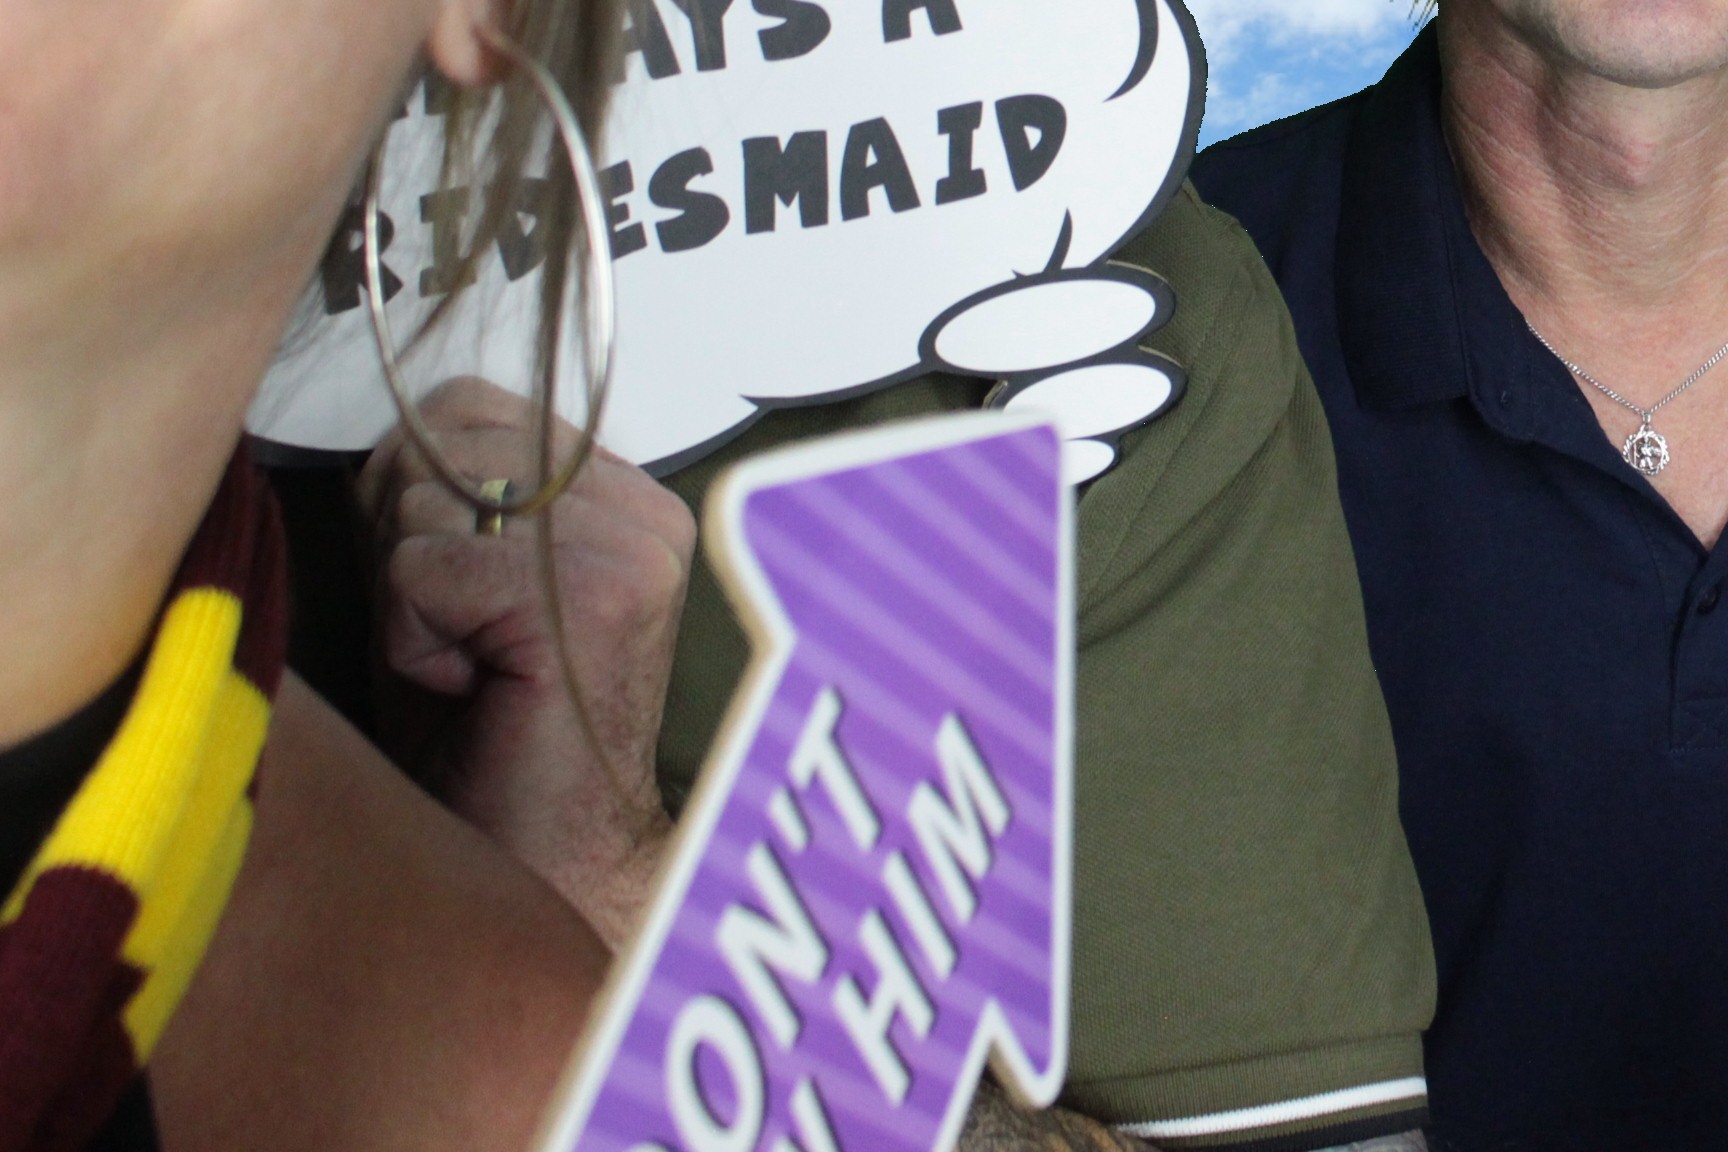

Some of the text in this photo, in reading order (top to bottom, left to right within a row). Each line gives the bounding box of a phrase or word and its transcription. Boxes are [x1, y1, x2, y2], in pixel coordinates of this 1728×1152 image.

[321, 94, 1067, 315] RIDESMAID
[630, 684, 880, 1152] ON'T
[831, 711, 1010, 1105] HIM
